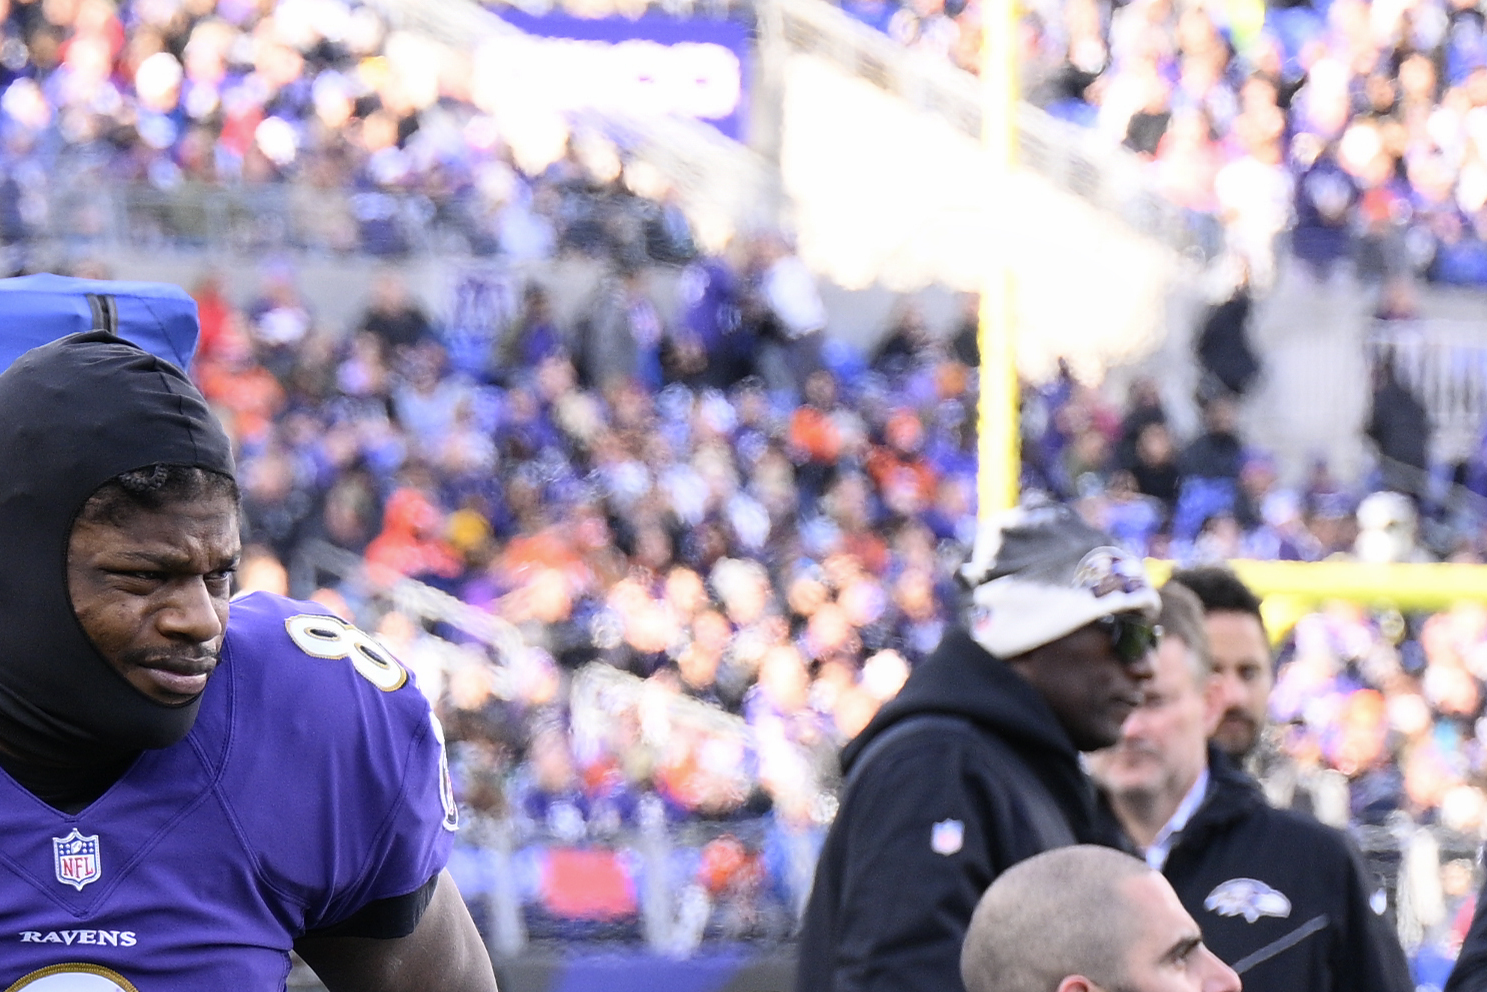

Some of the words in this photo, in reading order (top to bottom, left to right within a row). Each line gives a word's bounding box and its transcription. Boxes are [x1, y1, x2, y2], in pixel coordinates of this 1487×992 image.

[284, 614, 410, 692] 8
[62, 856, 94, 879] NFL
[18, 929, 138, 947] RAVENS
